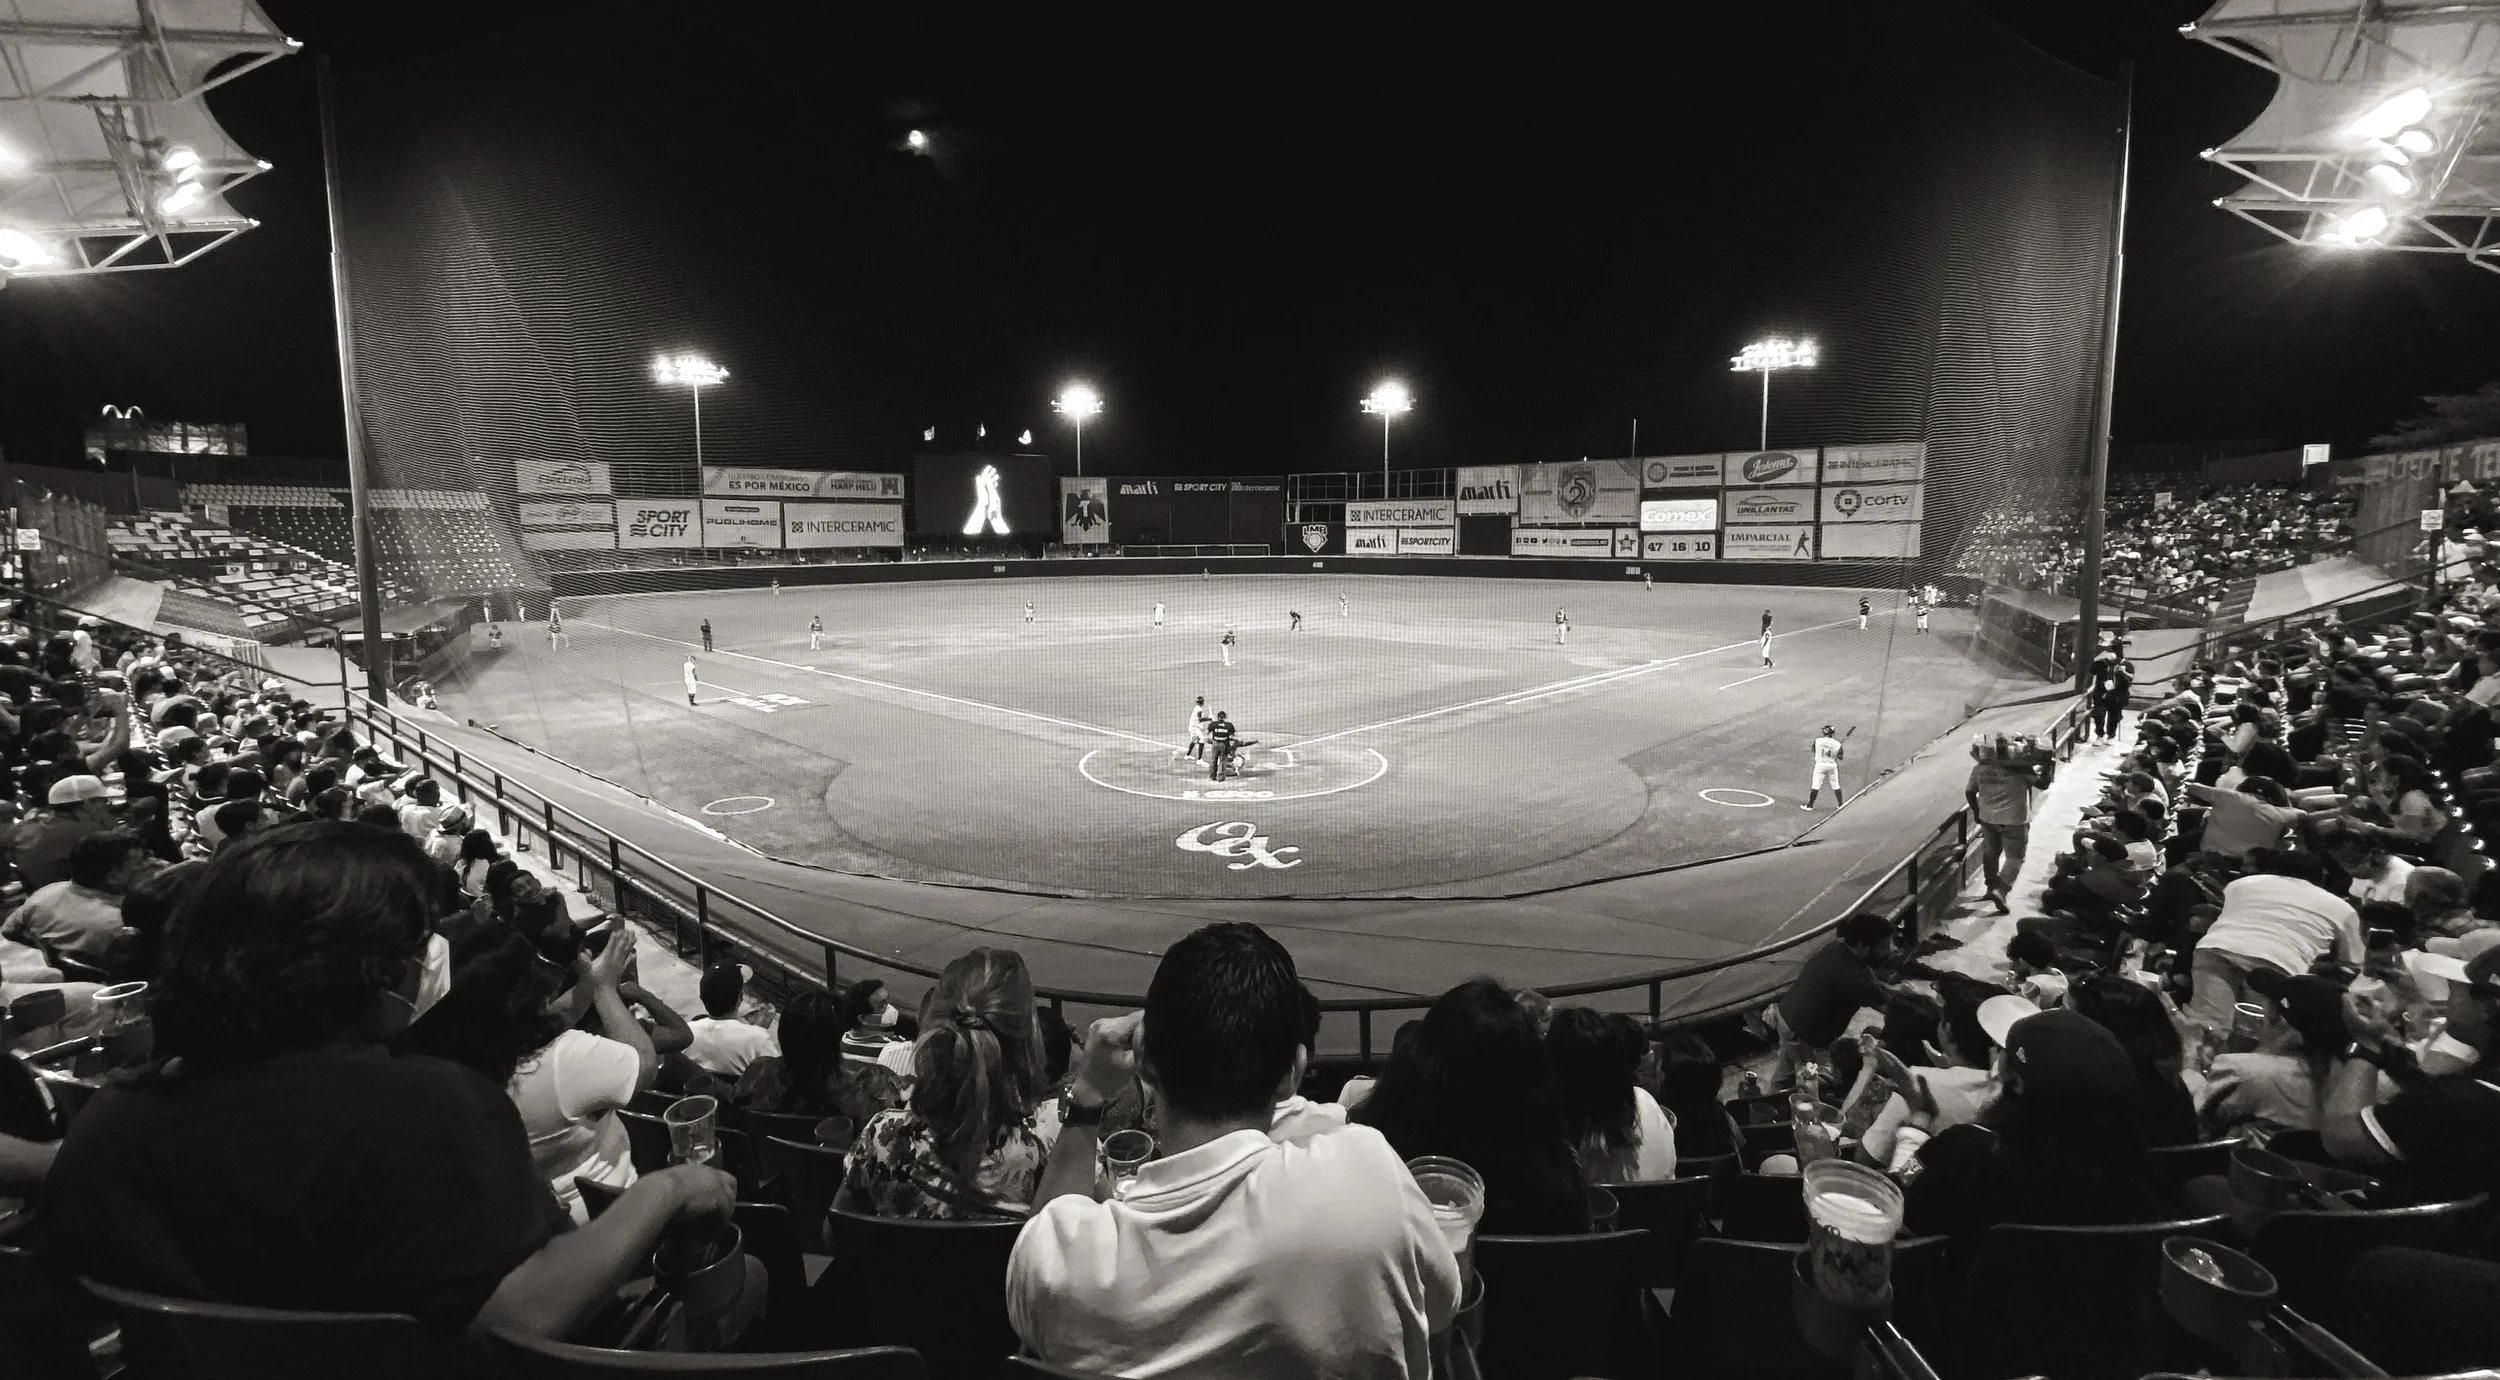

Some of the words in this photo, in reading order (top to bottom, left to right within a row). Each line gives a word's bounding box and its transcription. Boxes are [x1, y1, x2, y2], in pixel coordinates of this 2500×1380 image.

[729, 481, 742, 490] ES
[744, 481, 766, 490] POR
[1184, 483, 1208, 491] SPORT
[1209, 483, 1227, 491] CITY
[636, 510, 691, 523] SPORT
[1363, 508, 1446, 521] INTERCERAMIC
[650, 524, 688, 537] CITY
[807, 521, 895, 533] INTERCERAMIC
[1303, 525, 1328, 535] LMB
[1731, 533, 1791, 542] IMPARCIAL
[1647, 542, 1663, 551] 47
[1672, 542, 1686, 551] 16
[1695, 541, 1711, 551] 10
